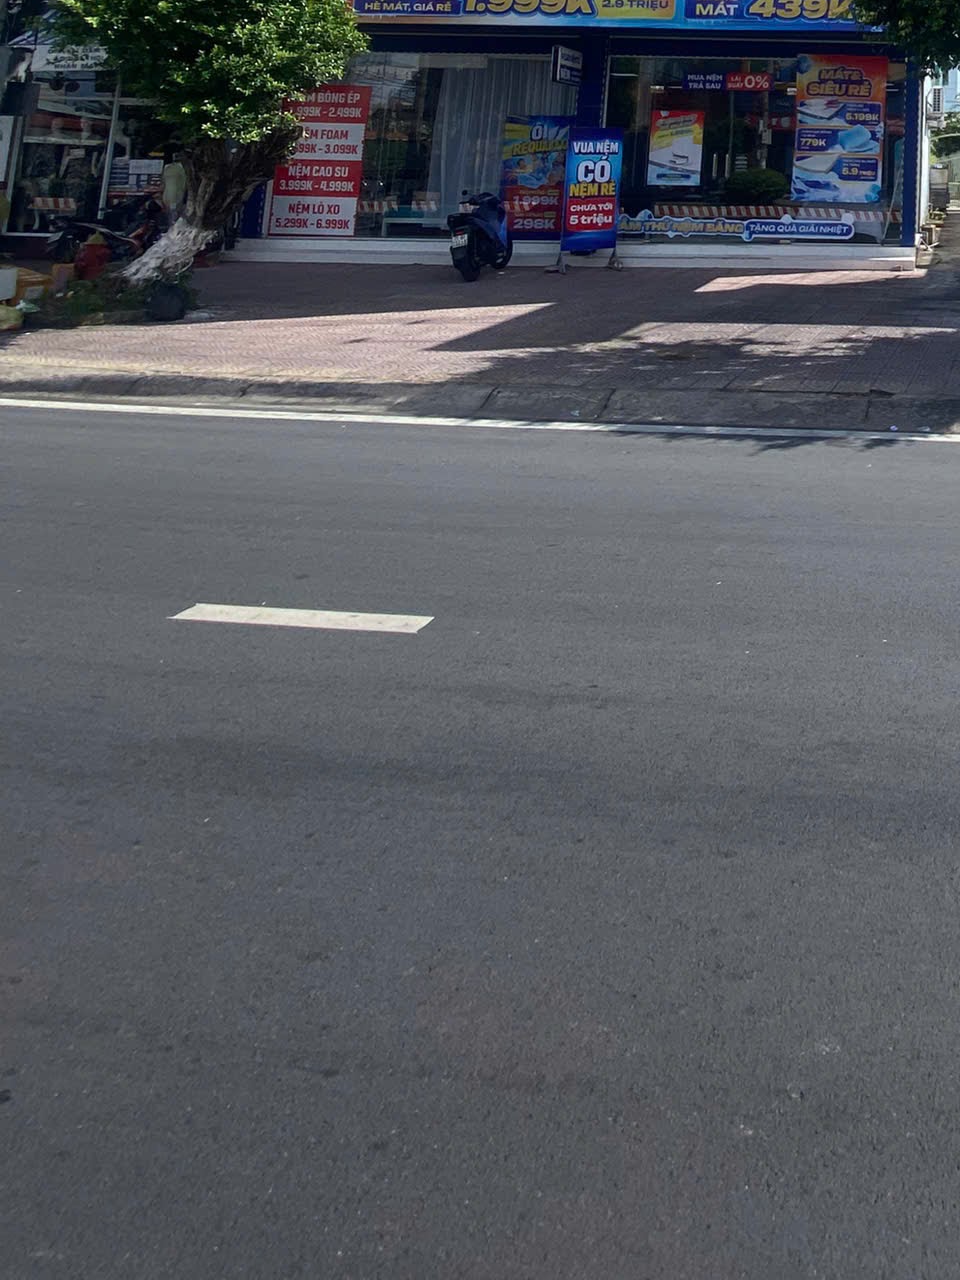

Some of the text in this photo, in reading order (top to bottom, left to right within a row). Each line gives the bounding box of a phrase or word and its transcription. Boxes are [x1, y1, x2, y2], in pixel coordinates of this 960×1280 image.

[413, 1, 435, 12] GIÁ
[695, 1, 738, 16] MÁT
[745, 75, 770, 89] 0%
[317, 90, 346, 104] BÔNG
[328, 106, 362, 118] 2.499K
[320, 129, 349, 140] FOAM
[325, 144, 359, 155] 3.099K
[573, 141, 595, 153] VUA
[596, 139, 619, 155] NỆM
[288, 163, 349, 178] NỆM CAO SU
[577, 155, 612, 183] CÓ
[279, 180, 354, 192] 3.999K 4.999K
[569, 181, 599, 198] NỆM
[288, 201, 310, 217] NỆM
[327, 203, 340, 215] XO
[570, 202, 597, 212] CHƯA
[275, 217, 350, 230] 5.299K 6.999K
[513, 218, 556, 230] 298K
[570, 215, 579, 225] 5
[580, 212, 613, 226] triệu
